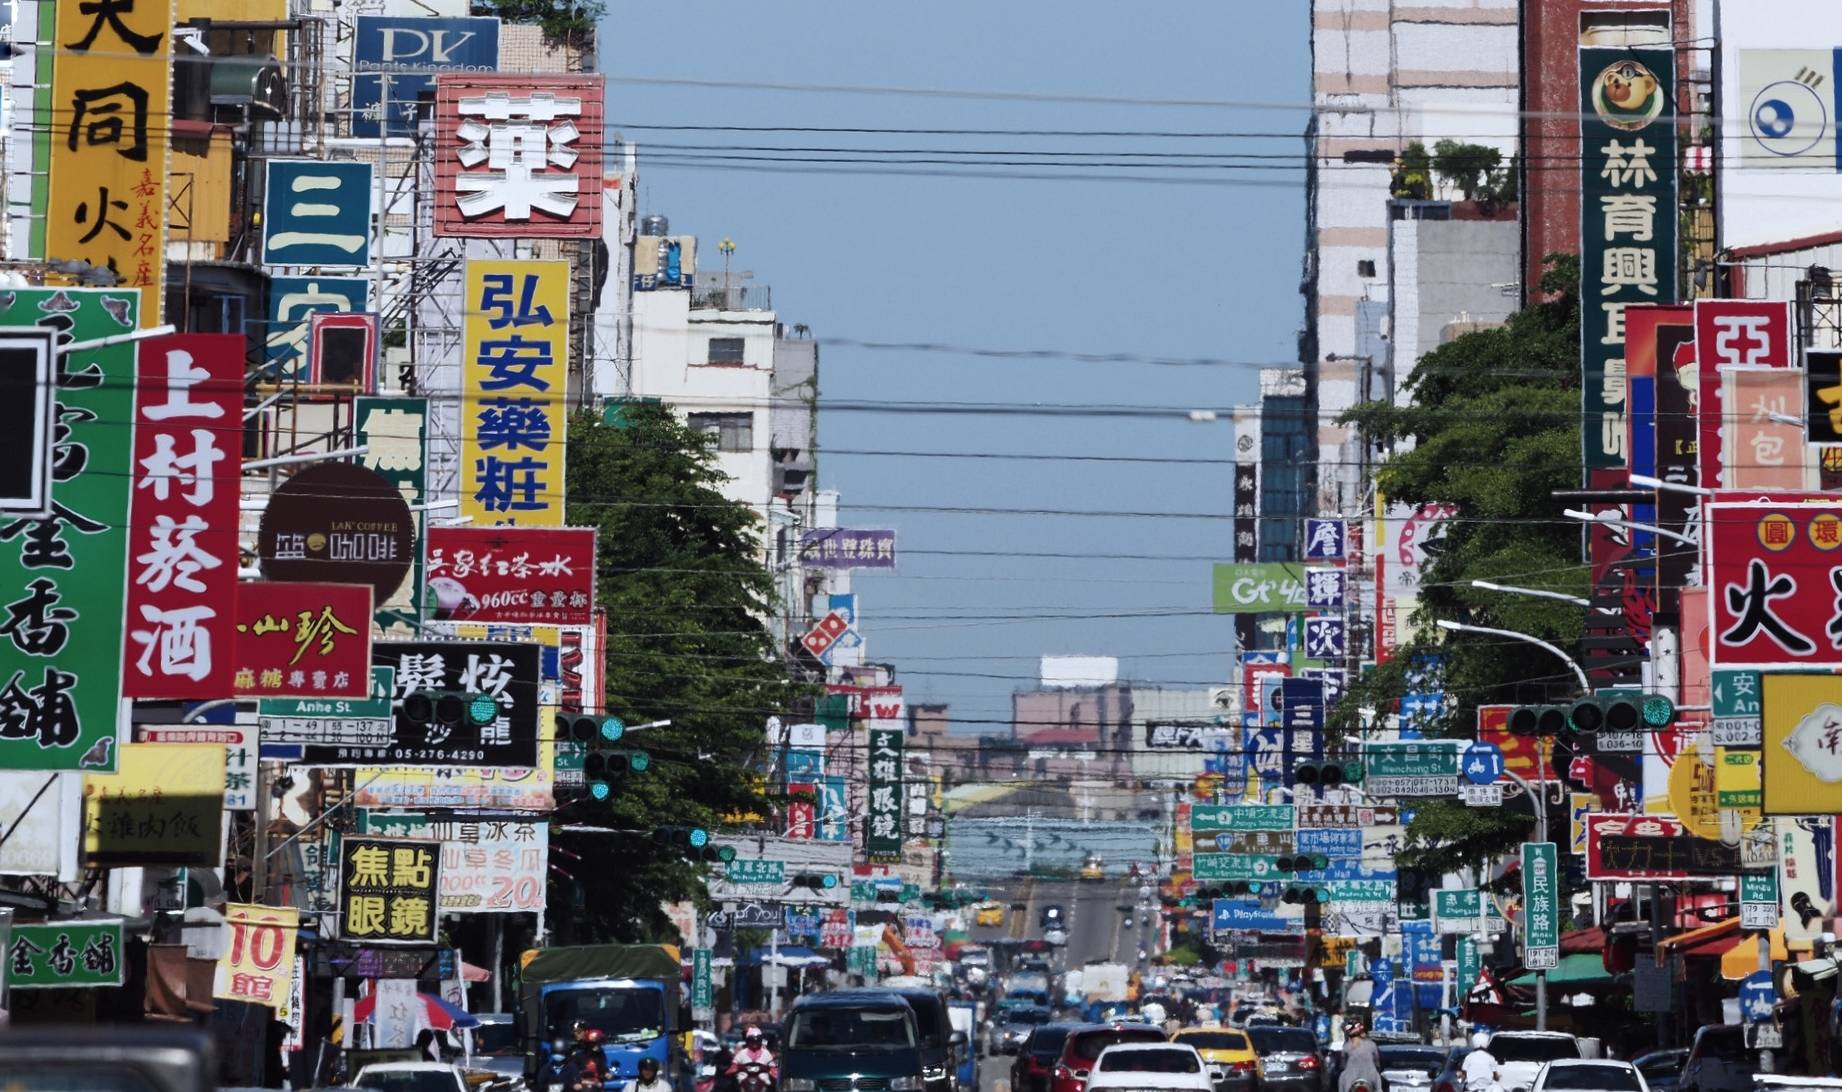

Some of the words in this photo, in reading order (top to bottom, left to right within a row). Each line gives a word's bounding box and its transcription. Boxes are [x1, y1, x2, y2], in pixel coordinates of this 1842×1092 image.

[474, 274, 554, 526] 弘安藥粧
[131, 350, 226, 682] 上村菸酒
[296, 701, 331, 712] Anhe
[350, 845, 432, 888] 焦點
[348, 896, 429, 936] 眼鏡
[1531, 875, 1551, 931] 民族路
[9, 935, 116, 976] 金香鋪
